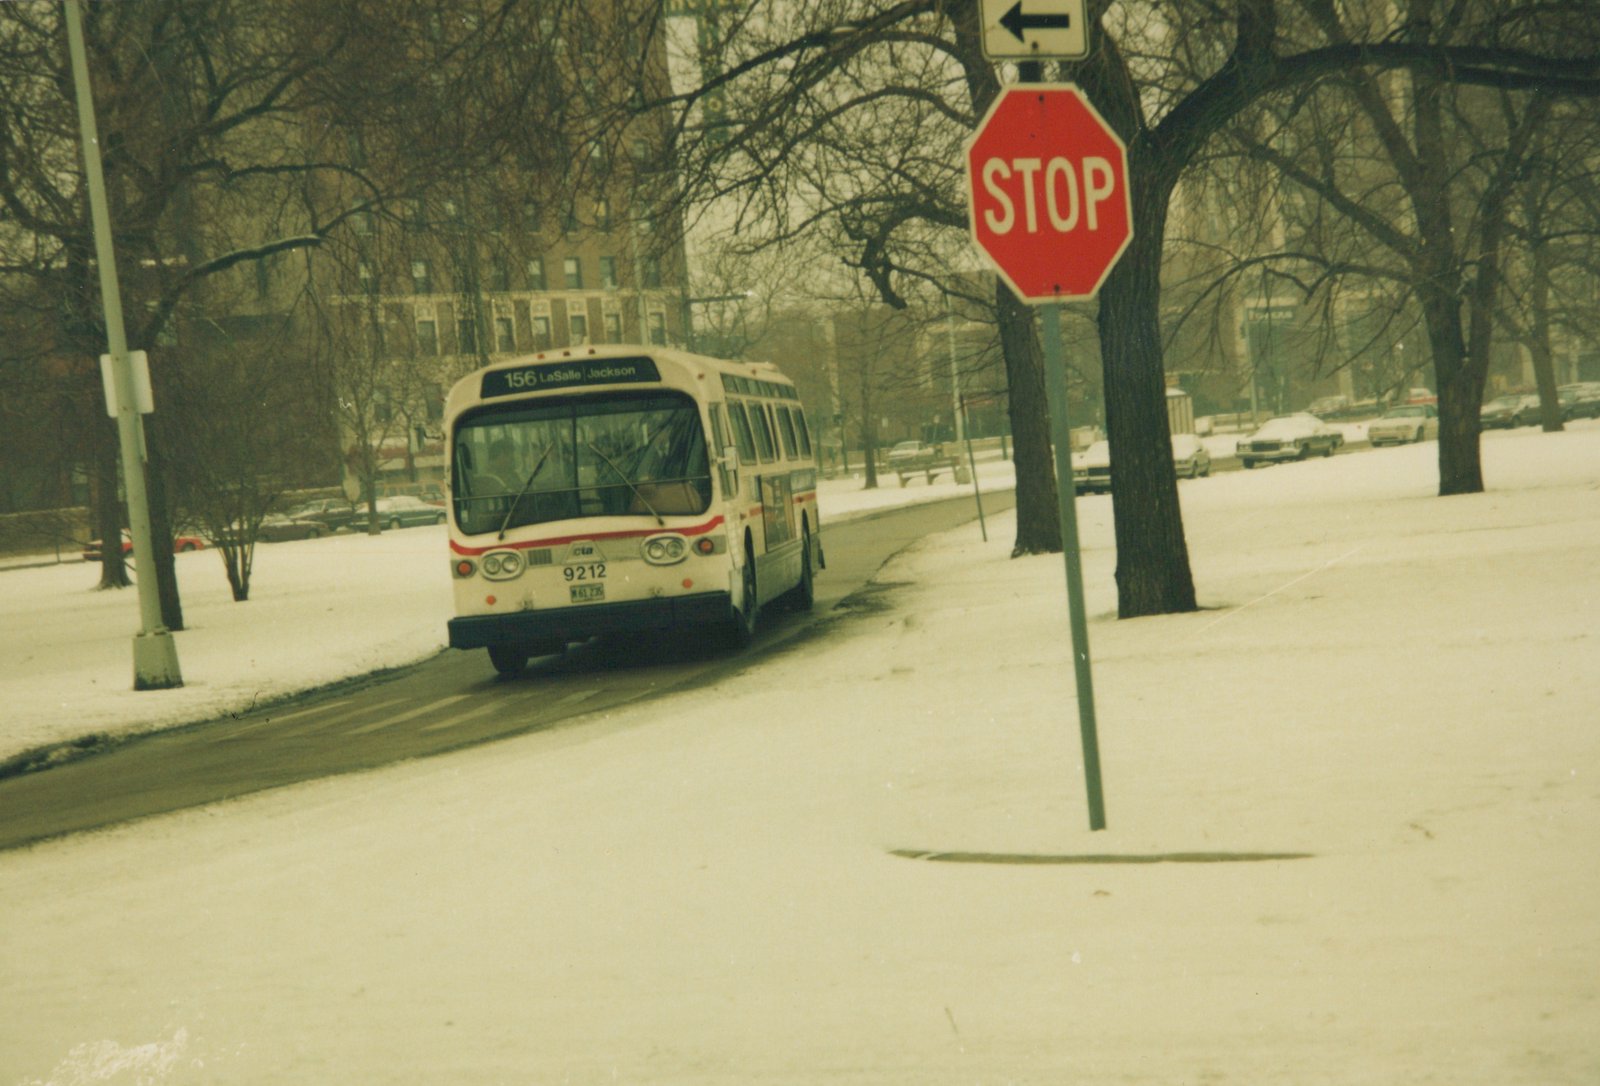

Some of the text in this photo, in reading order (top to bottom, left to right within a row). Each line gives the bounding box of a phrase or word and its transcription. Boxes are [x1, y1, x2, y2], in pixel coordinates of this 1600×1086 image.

[982, 156, 1115, 235] STOP
[505, 365, 636, 388] 156 LaSalle Jackson
[563, 564, 606, 582] 9212
